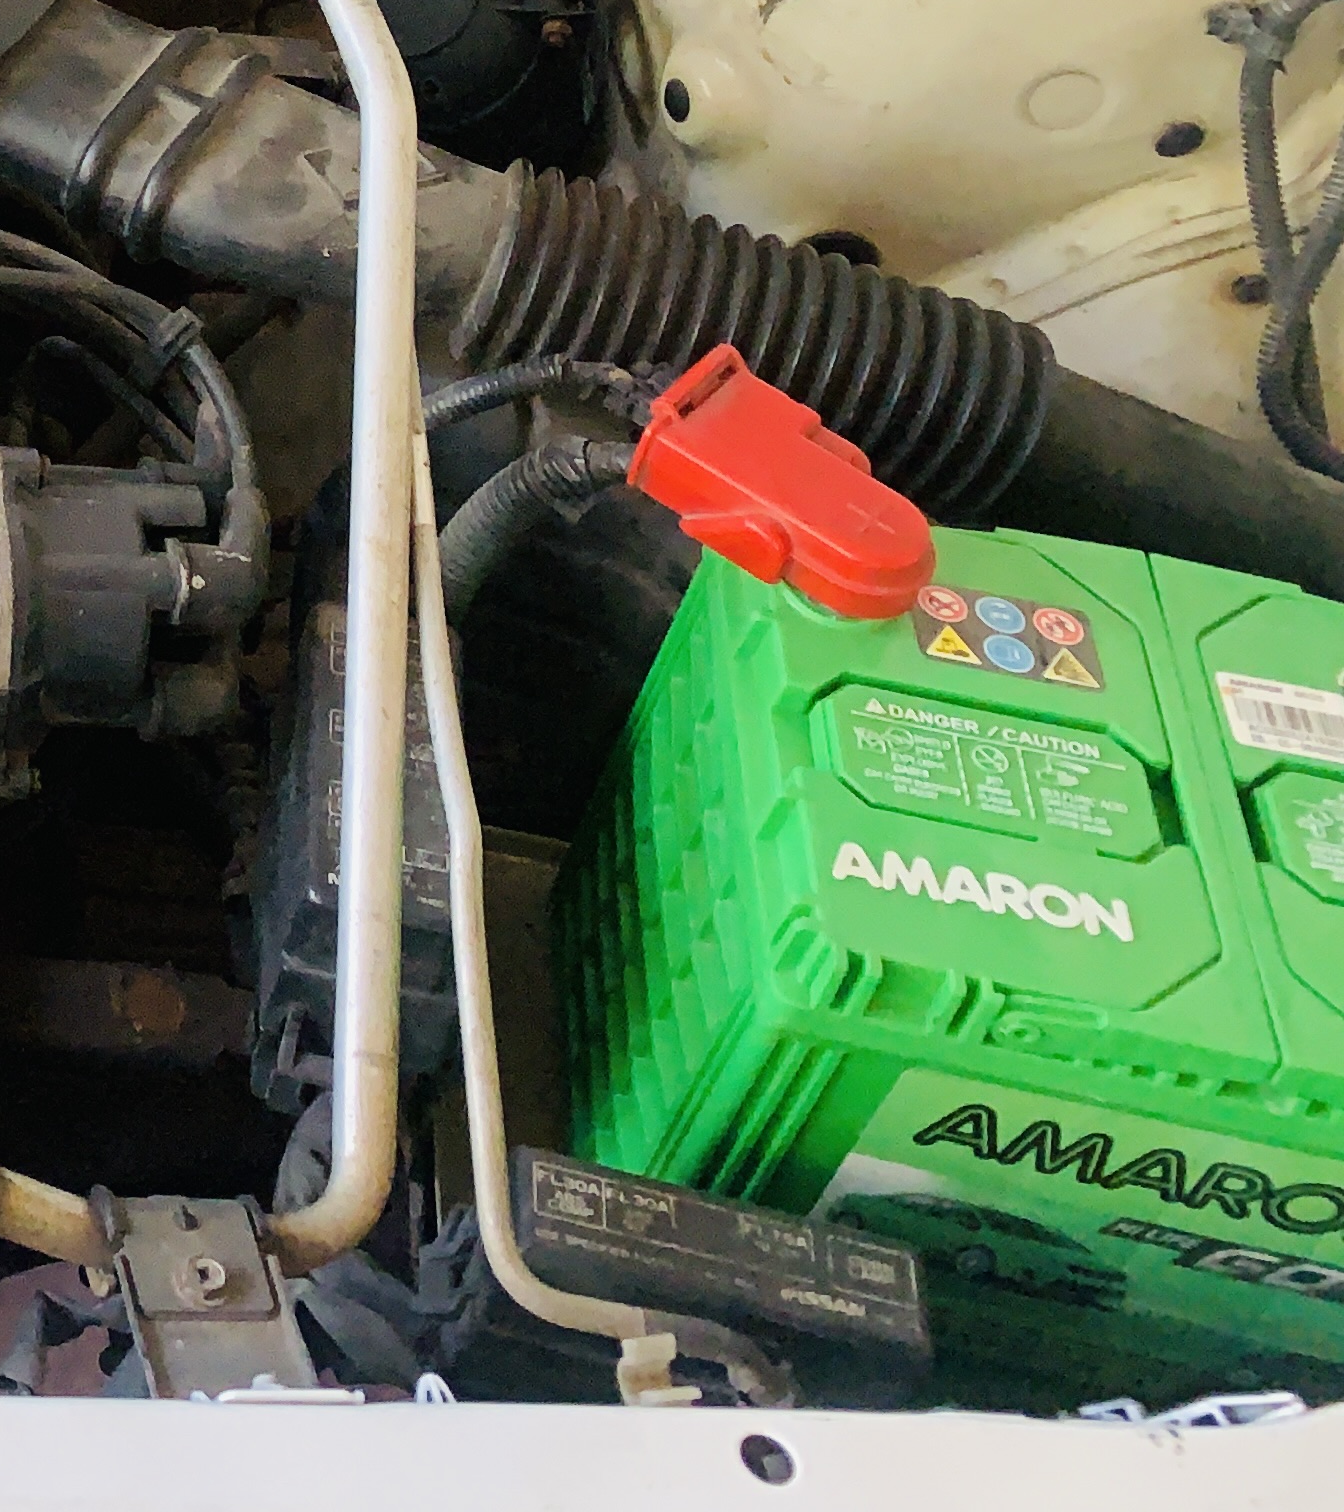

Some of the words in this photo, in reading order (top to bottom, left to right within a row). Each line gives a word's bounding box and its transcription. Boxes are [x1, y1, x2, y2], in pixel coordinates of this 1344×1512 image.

[889, 703, 979, 734] DANGER
[1002, 726, 1100, 759] CAUTION
[832, 841, 1134, 942] AMARON
